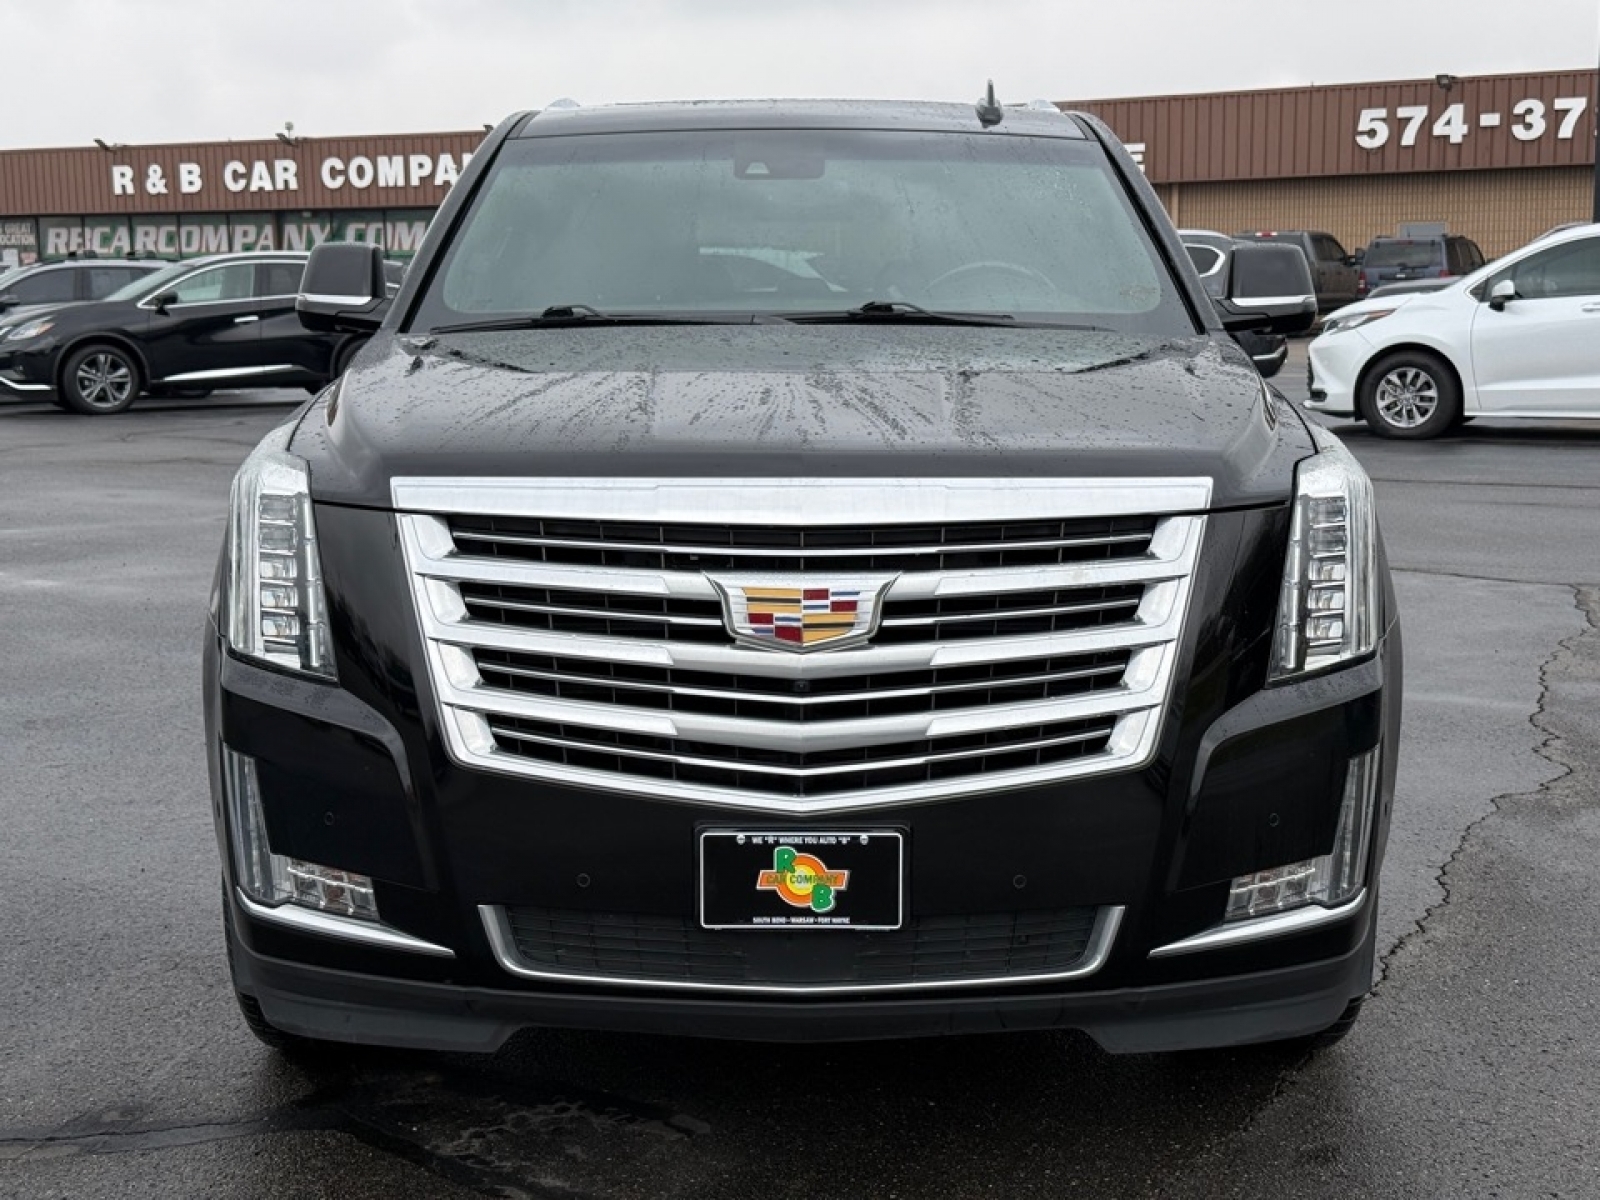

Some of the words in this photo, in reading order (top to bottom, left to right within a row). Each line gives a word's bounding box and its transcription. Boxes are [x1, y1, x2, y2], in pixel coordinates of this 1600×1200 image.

[1355, 97, 1596, 149] 574-37
[112, 165, 134, 195] R
[146, 164, 168, 194] &
[180, 162, 202, 193] B
[224, 160, 298, 192] CAR
[752, 836, 763, 844] WE
[804, 836, 819, 844] YOU
[774, 847, 796, 873] R
[767, 873, 787, 884] CAR
[789, 872, 837, 884] COMPANY
[811, 883, 835, 911] B
